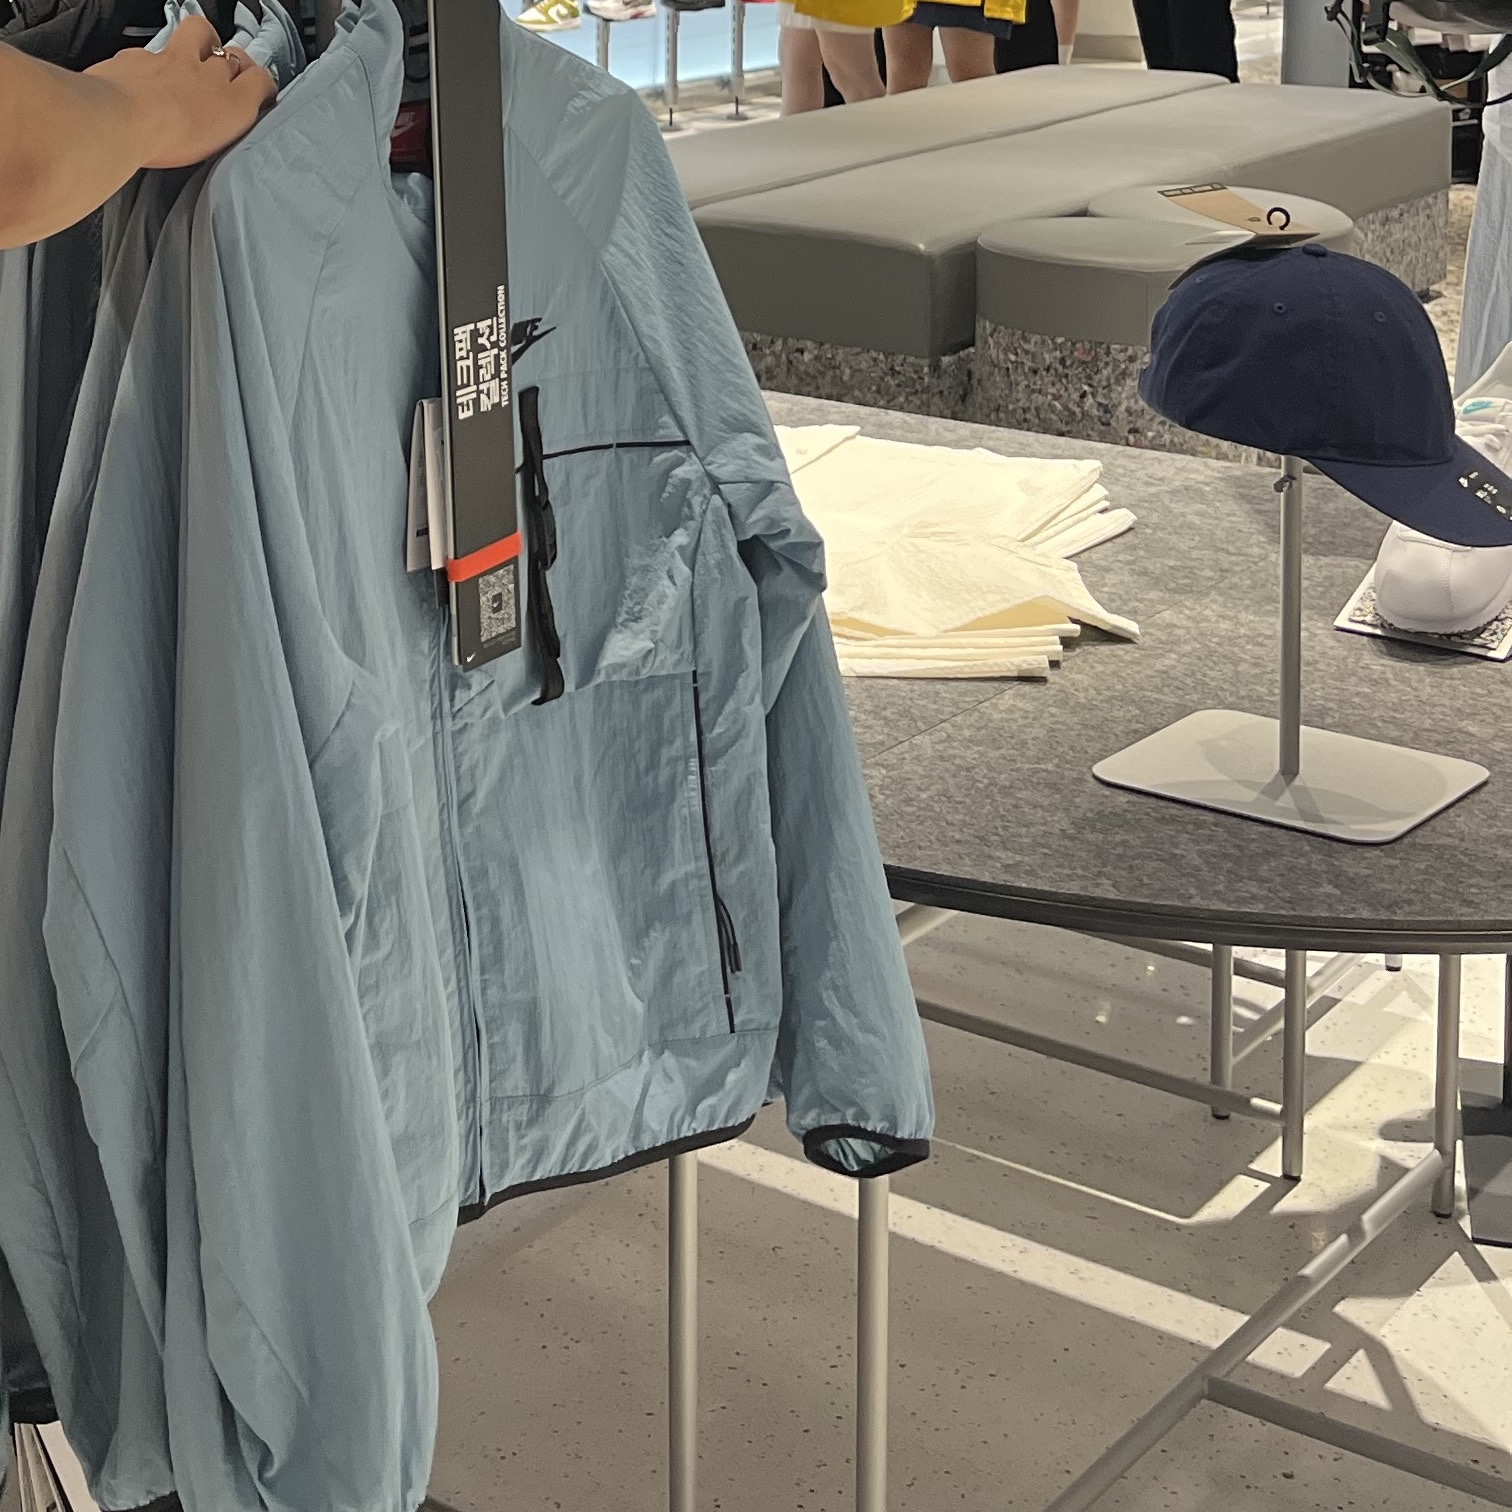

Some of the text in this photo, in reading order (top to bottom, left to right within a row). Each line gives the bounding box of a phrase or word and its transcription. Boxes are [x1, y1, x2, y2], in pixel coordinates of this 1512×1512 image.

[453, 322, 478, 420] 테크팩
[476, 316, 500, 413] 컬렉션
[496, 284, 509, 408] TECH PACK COLLECTION
